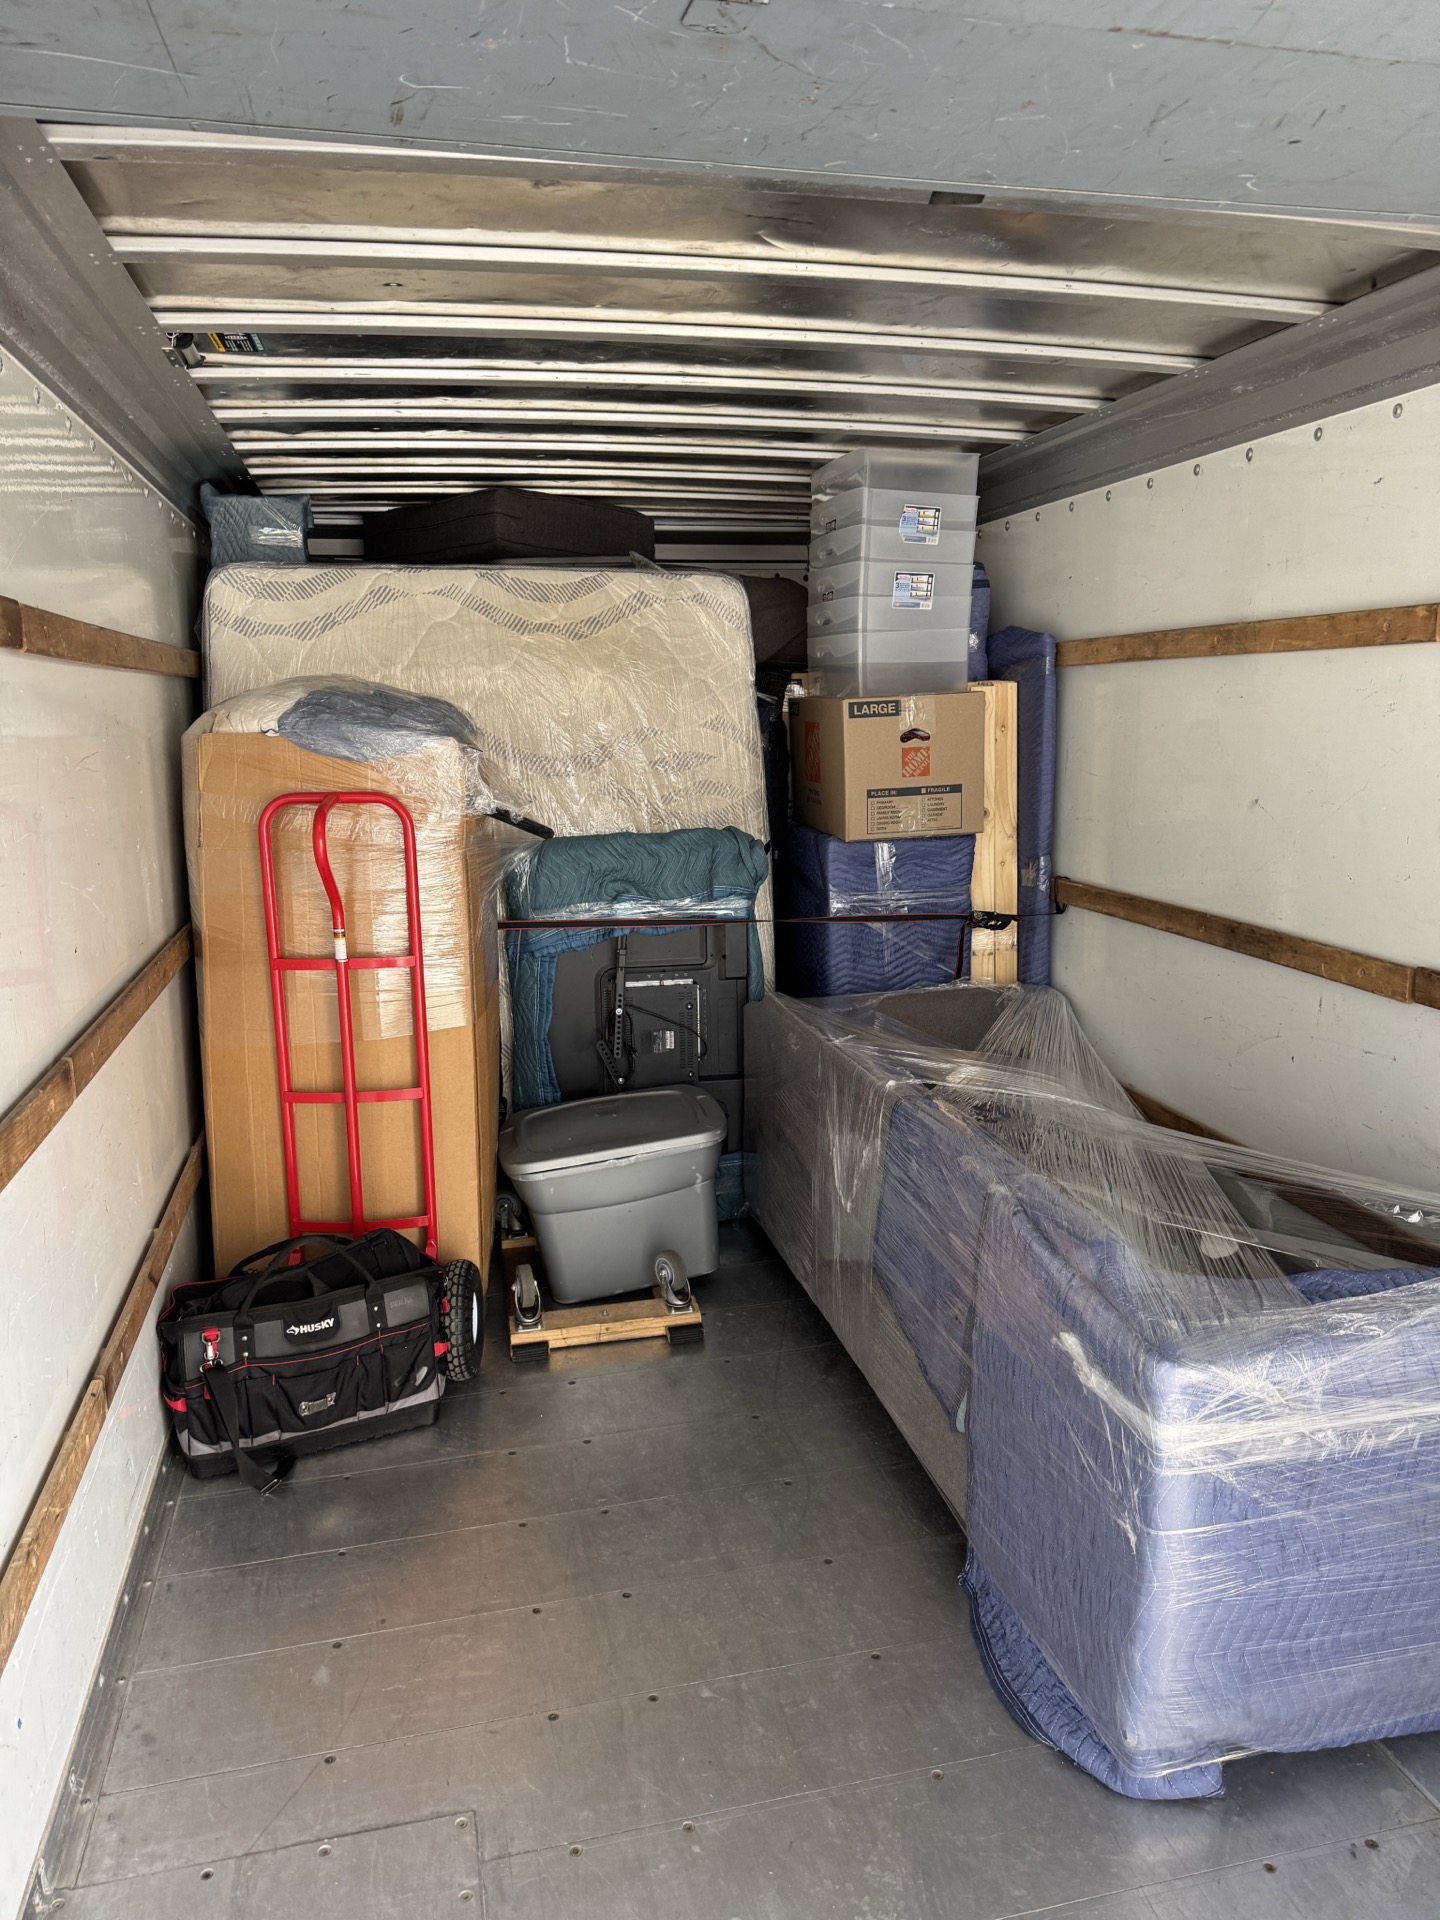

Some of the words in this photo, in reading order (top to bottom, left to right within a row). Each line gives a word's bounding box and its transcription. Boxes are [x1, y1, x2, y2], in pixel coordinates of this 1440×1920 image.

[853, 702, 896, 715] LARGE
[902, 746, 930, 777] HOME
[905, 751, 916, 762] THE
[913, 758, 930, 777] DEPOT
[299, 1317, 335, 1334] HUSKY
